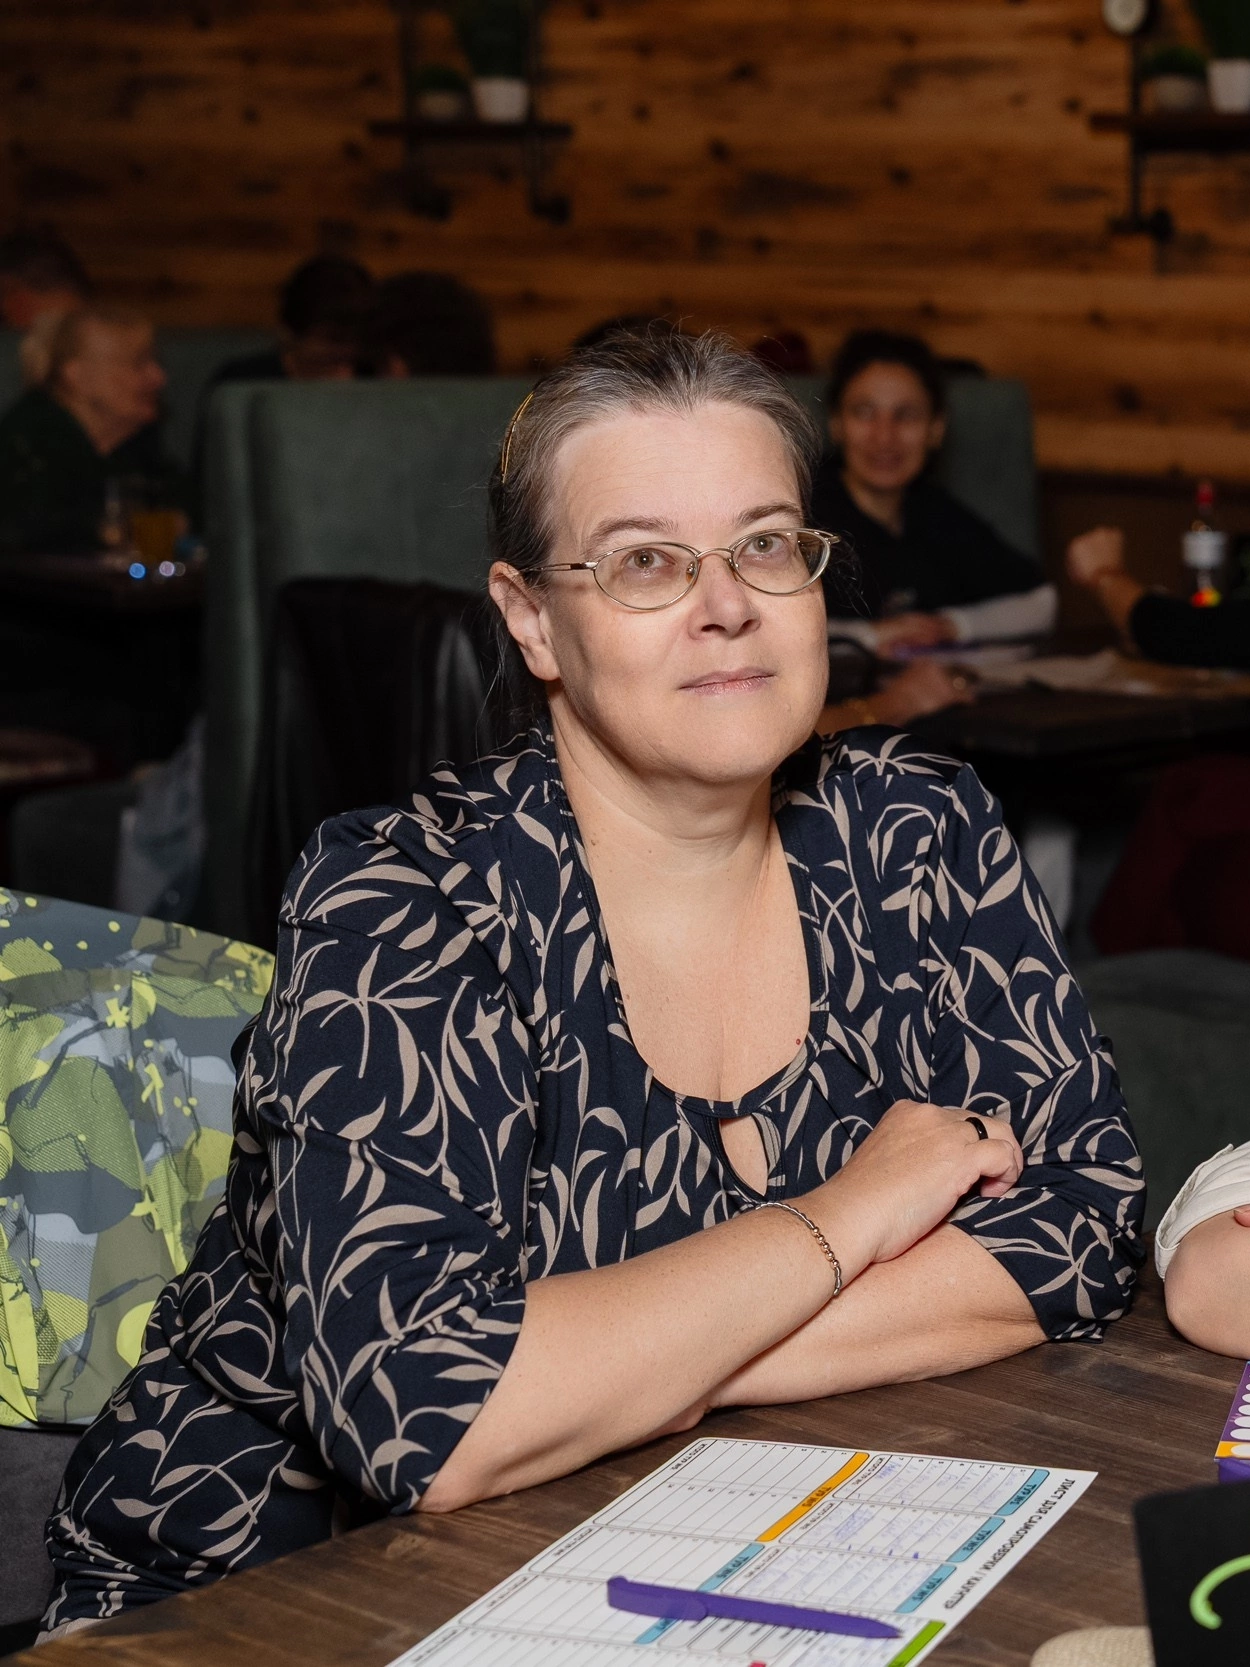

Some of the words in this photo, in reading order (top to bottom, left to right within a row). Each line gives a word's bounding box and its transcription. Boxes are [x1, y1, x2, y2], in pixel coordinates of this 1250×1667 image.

[815, 1487, 832, 1497] ТУР
[1021, 1484, 1037, 1495] ТУР
[1052, 1478, 1075, 1499] ЛИСТ
[1010, 1495, 1025, 1505] №1
[1036, 1500, 1057, 1514] ДЛЯ
[975, 1530, 992, 1541] ТУР
[982, 1515, 1042, 1570] САМОПРОВЕРКИ
[732, 1556, 749, 1567] ТУР
[926, 1578, 942, 1589] ТУР
[943, 1576, 981, 1610] КАУНТЕР
